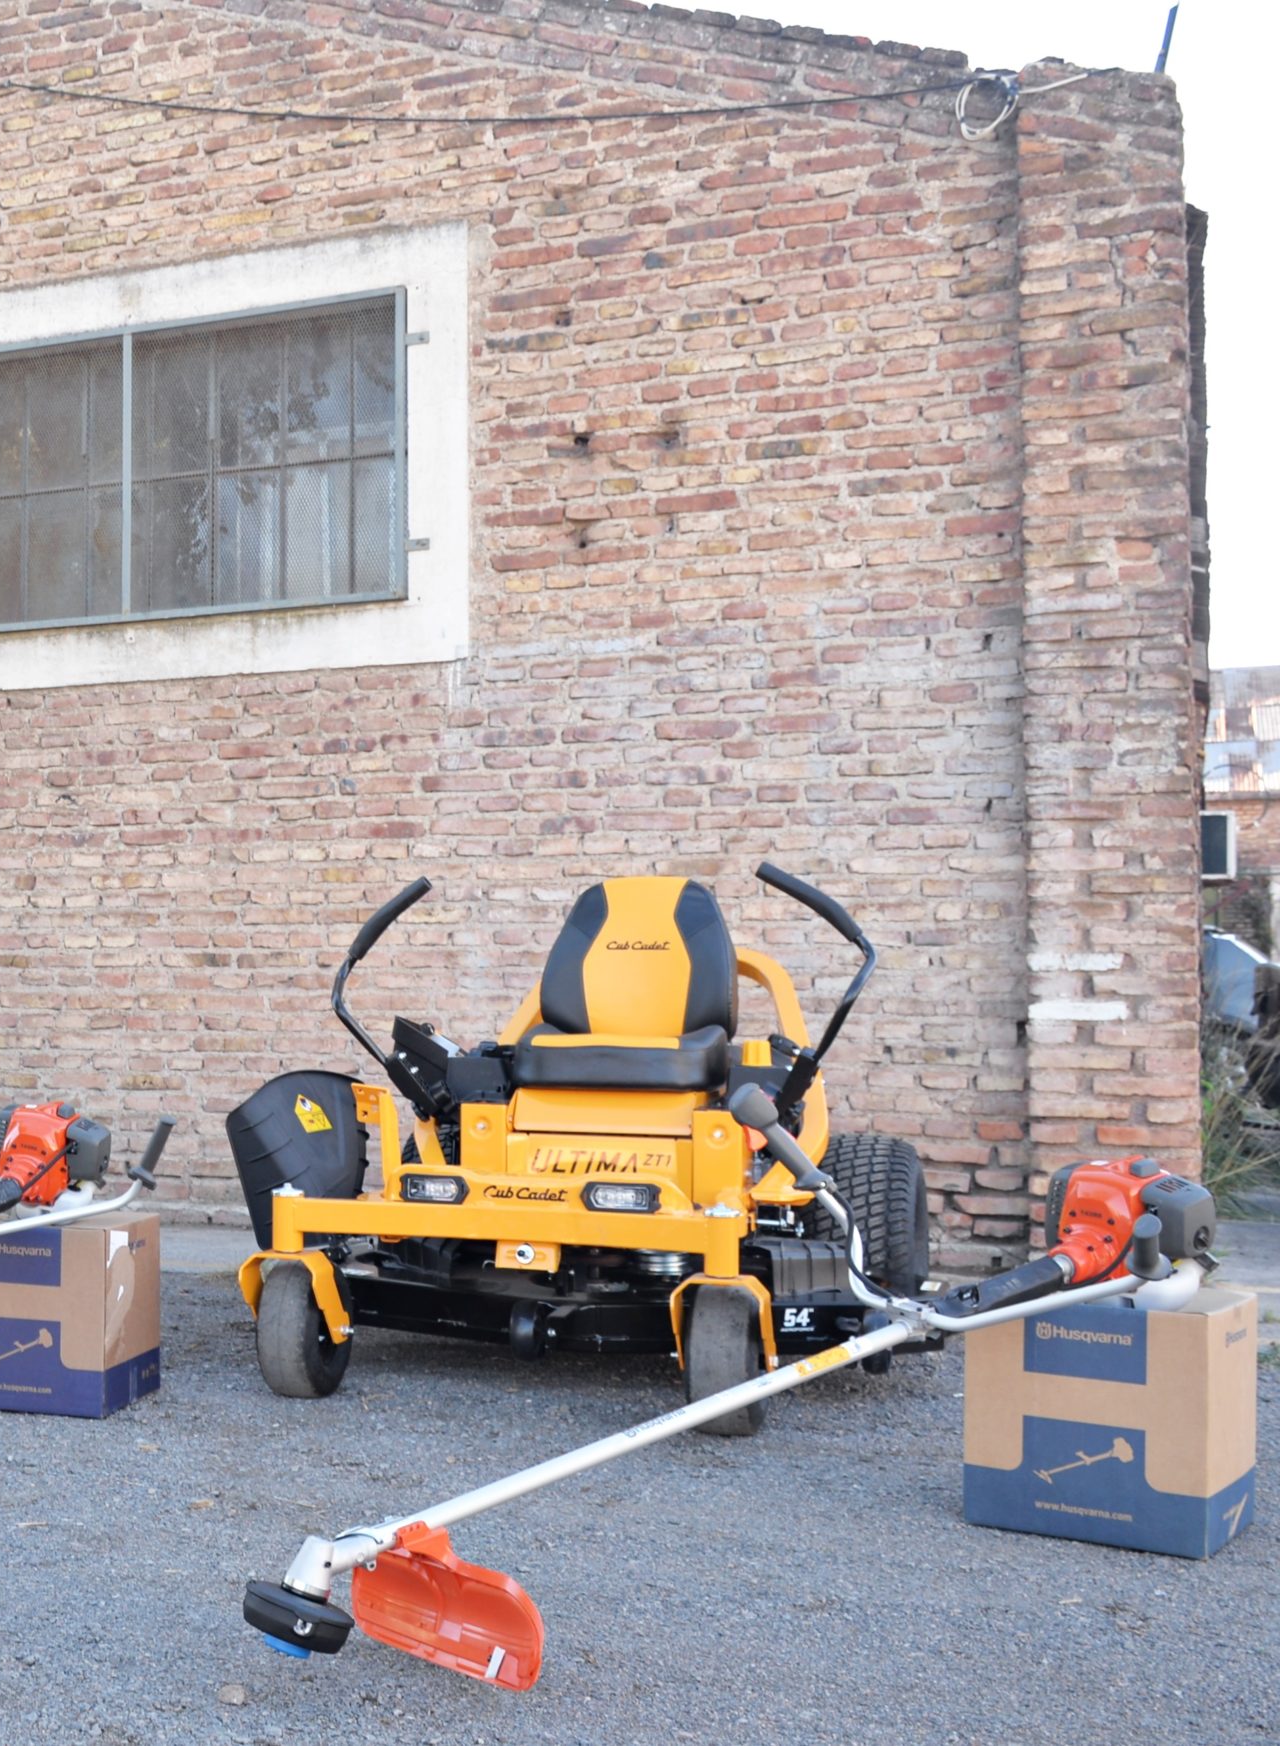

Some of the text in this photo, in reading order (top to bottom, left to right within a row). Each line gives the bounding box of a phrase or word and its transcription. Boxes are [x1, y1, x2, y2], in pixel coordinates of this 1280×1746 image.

[606, 940, 671, 951] Cub Cadet
[531, 1147, 672, 1174] ULTIMA ZT1
[483, 1184, 568, 1201] Cub Cadet
[1052, 1325, 1132, 1346] Husqvarna
[1034, 1499, 1133, 1522] www.husqvarna.com
